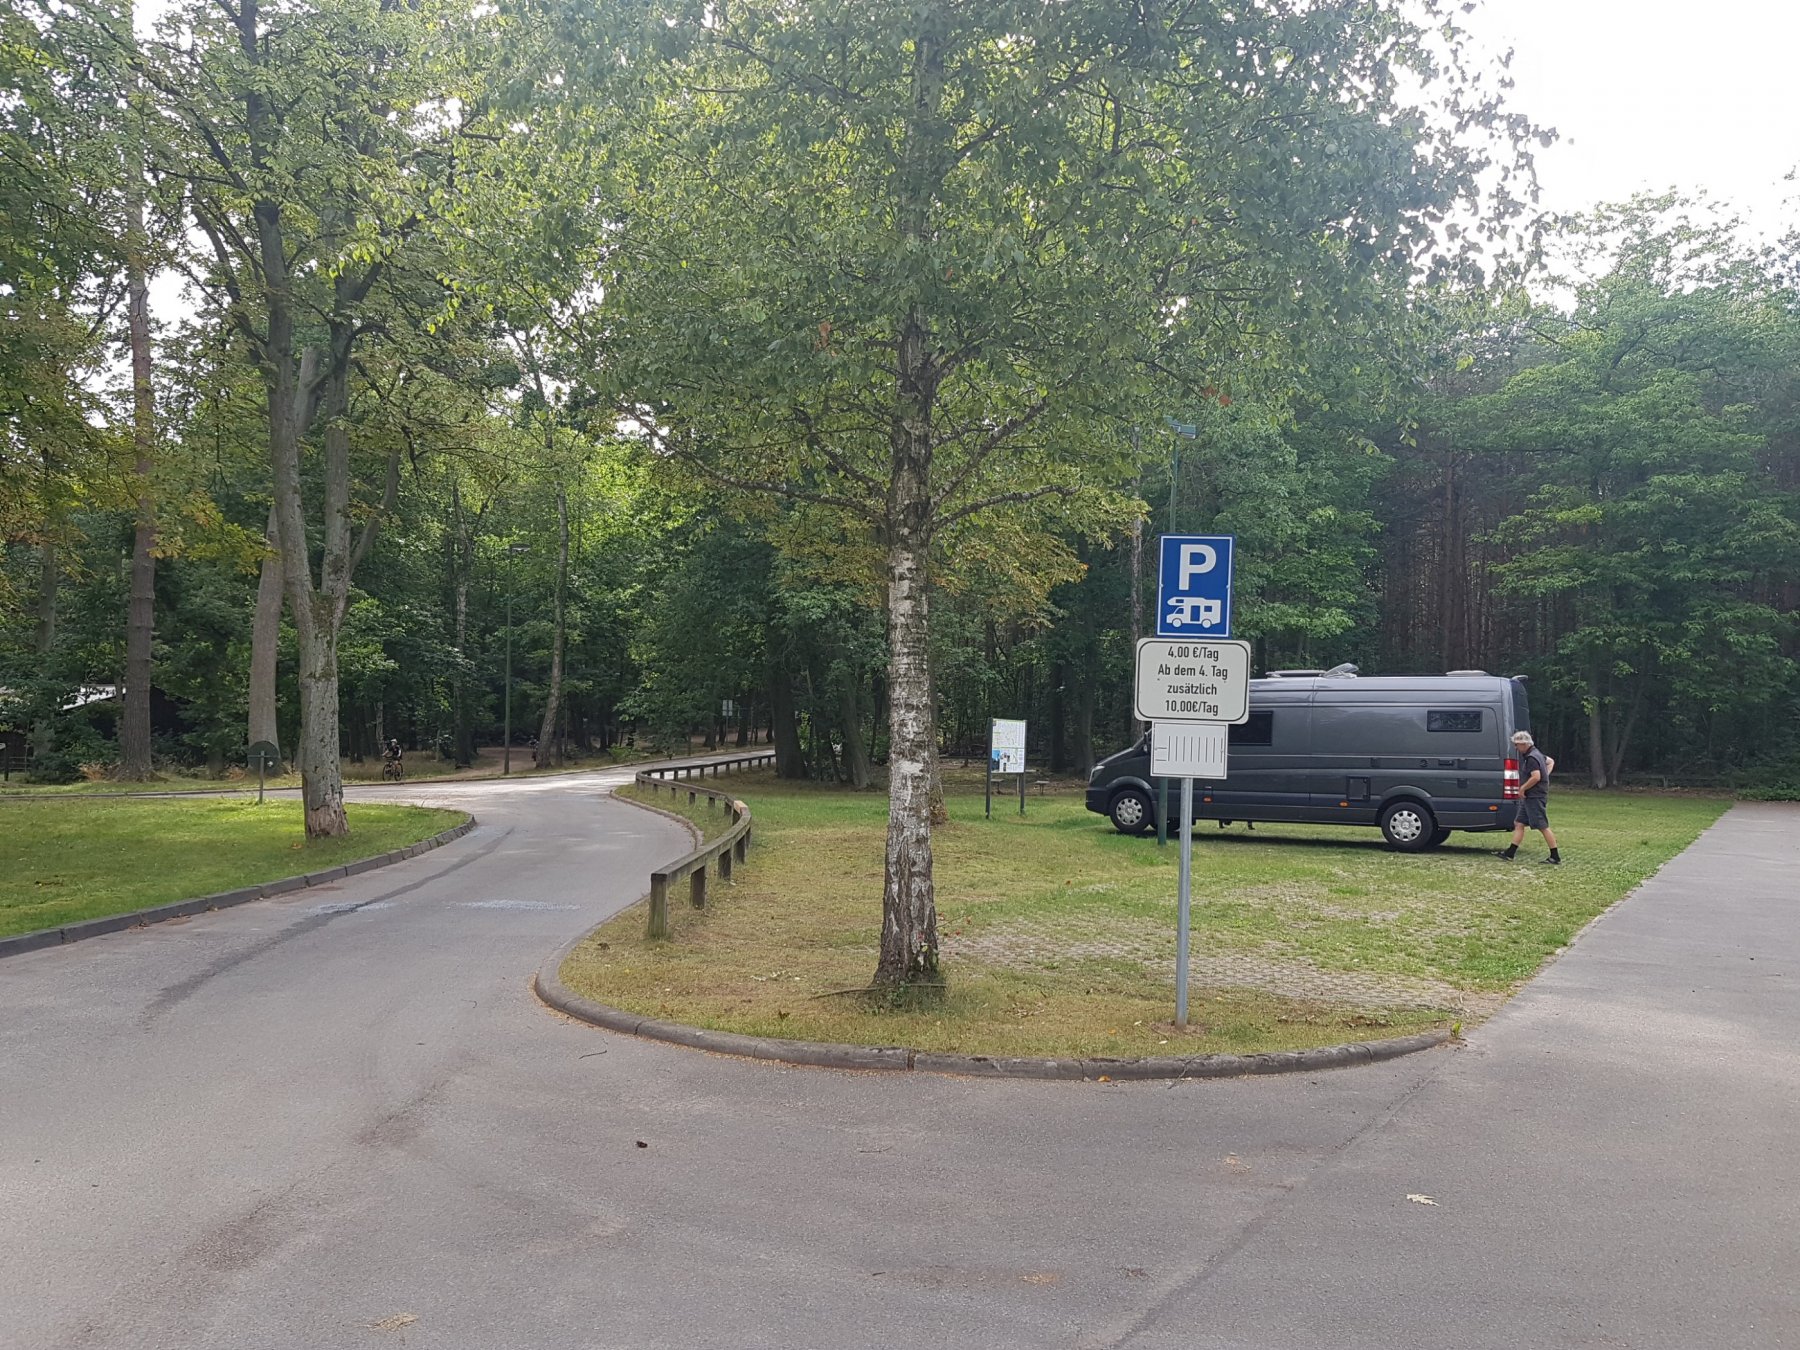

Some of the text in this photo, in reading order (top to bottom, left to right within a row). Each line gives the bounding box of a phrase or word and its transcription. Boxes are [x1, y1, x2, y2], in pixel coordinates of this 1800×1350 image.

[1179, 544, 1217, 591] P
[1193, 647, 1219, 662] €/Tag
[1158, 664, 1228, 681] Ab dem 4. Tag
[1167, 683, 1217, 695] zusätzlich
